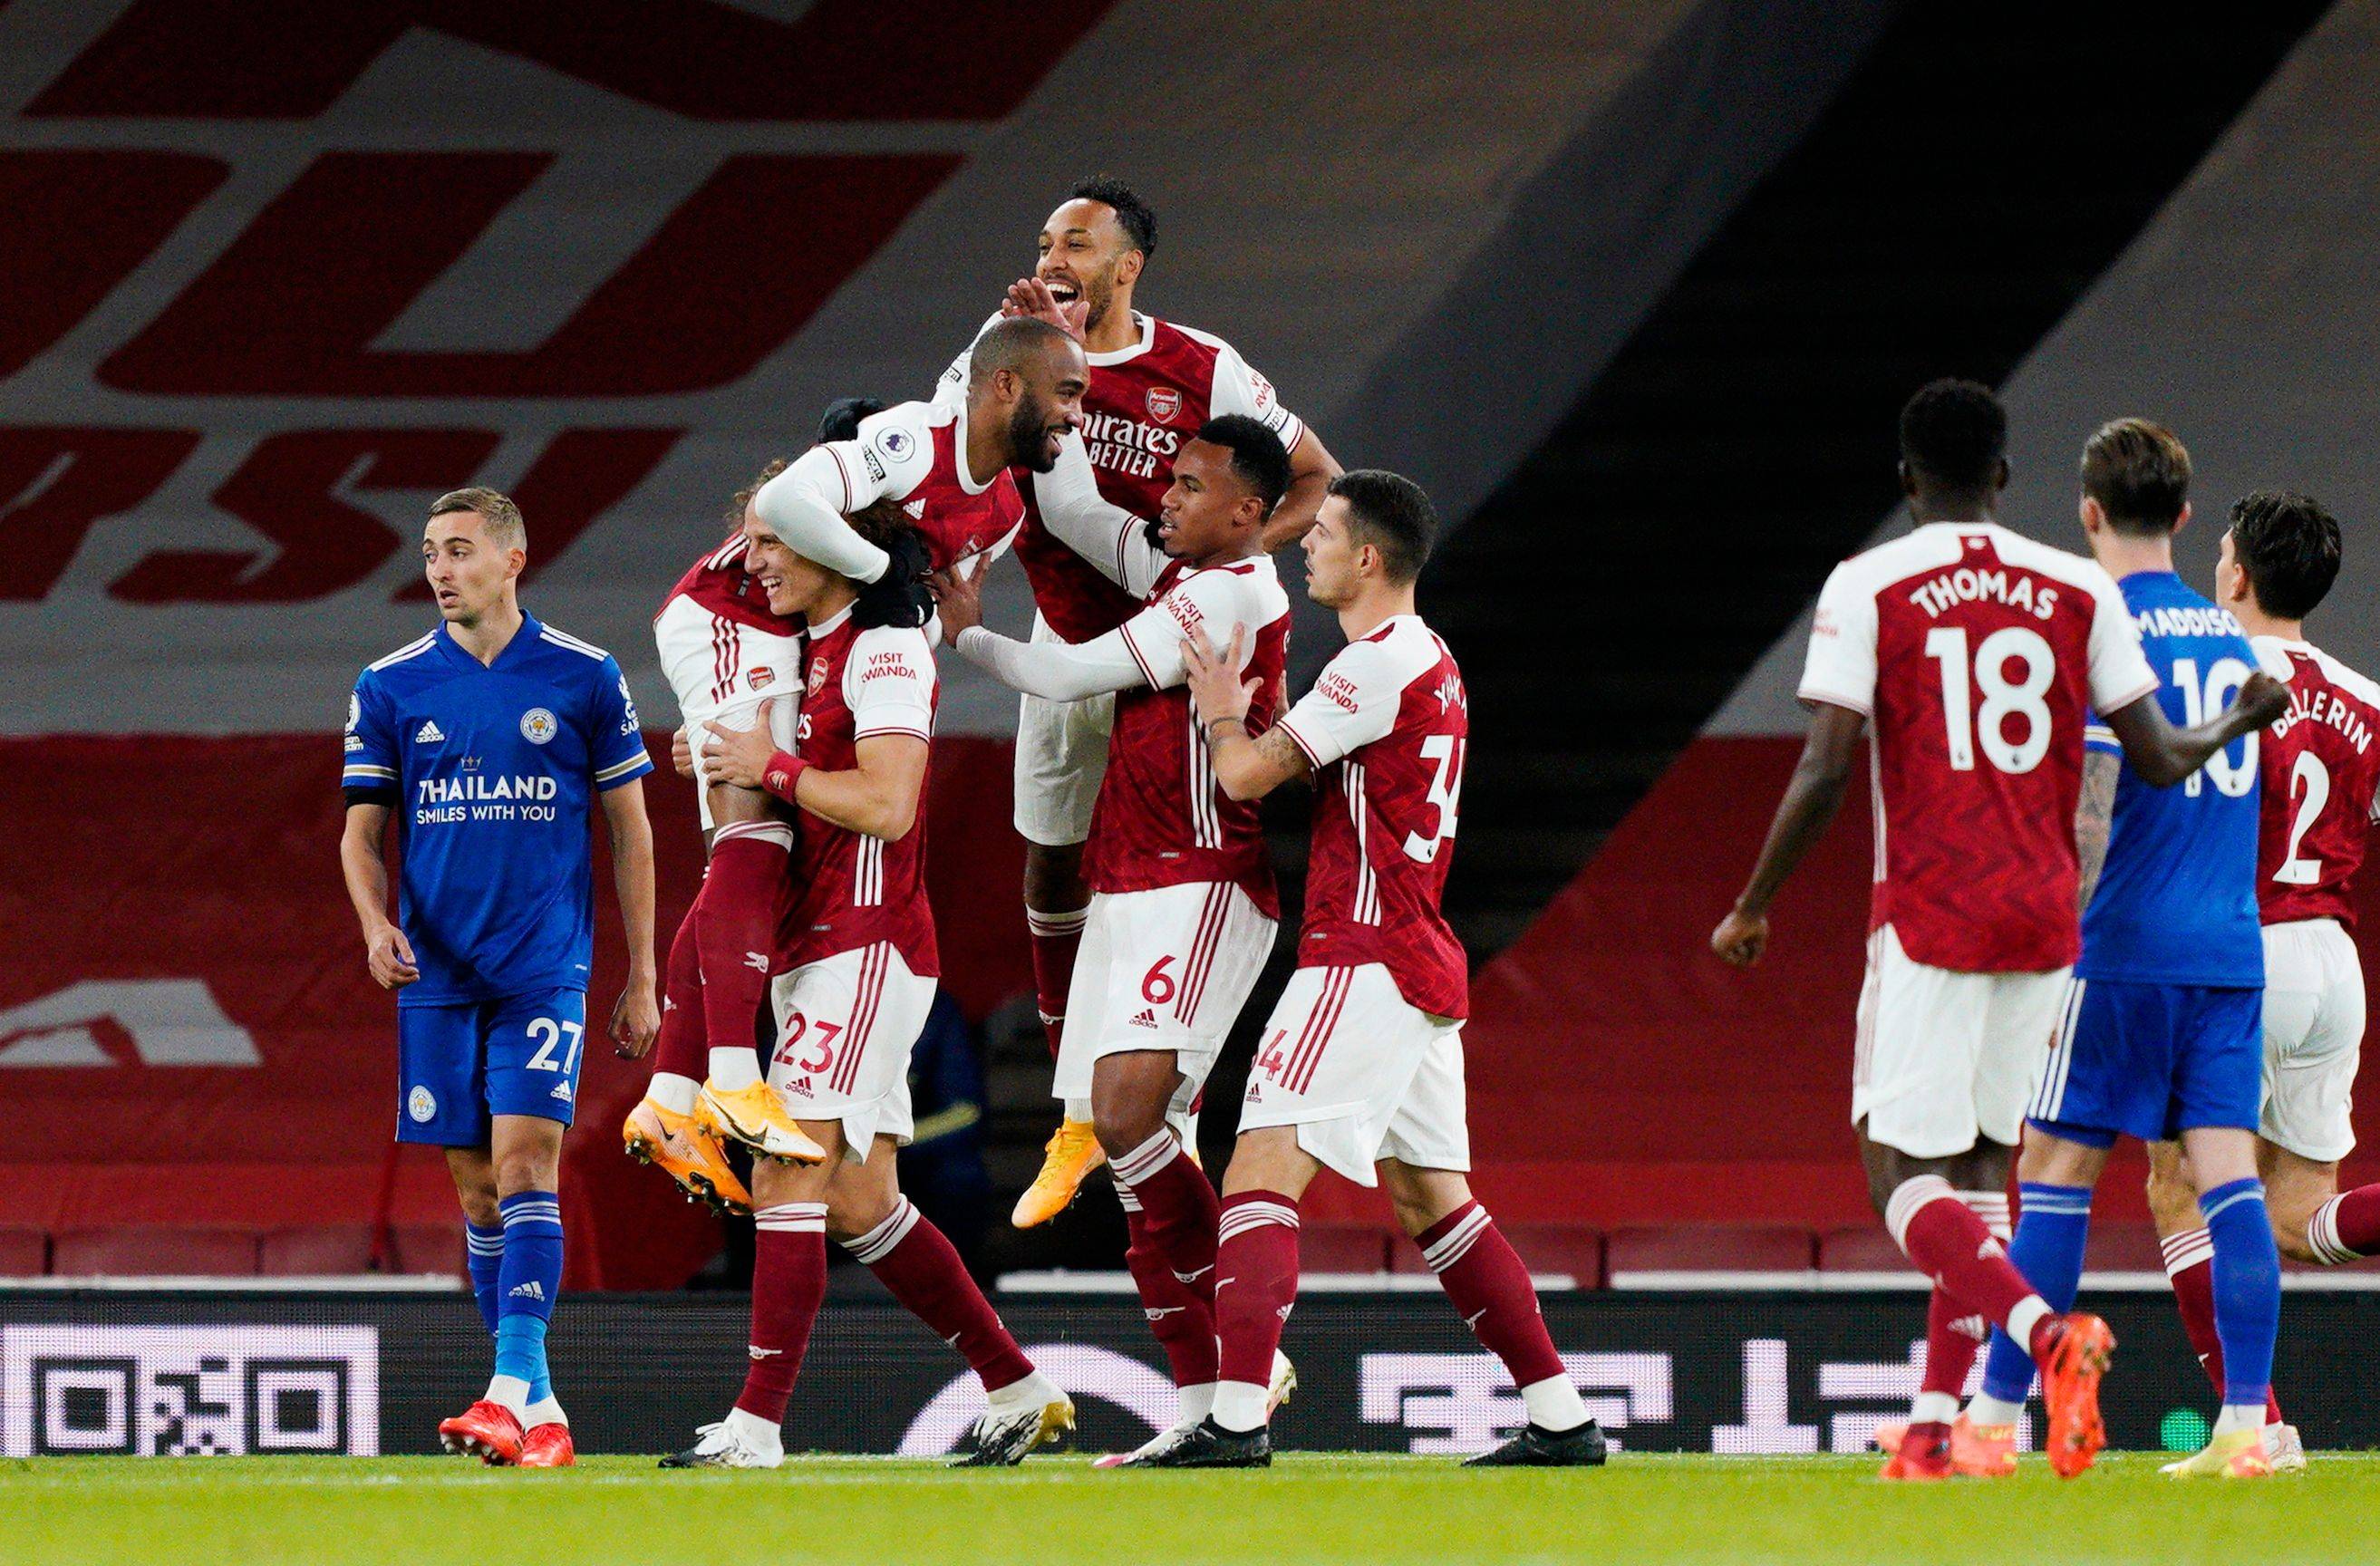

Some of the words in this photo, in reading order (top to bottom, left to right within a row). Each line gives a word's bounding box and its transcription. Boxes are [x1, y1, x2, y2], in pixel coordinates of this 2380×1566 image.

[1082, 410, 1178, 455] irates
[1089, 441, 1156, 478] BETTER
[1179, 592, 1205, 623] VISIT
[1909, 568, 2059, 620] THOMAS
[1166, 594, 1197, 644] WAND
[2137, 606, 2243, 636] MADDISO
[869, 652, 904, 665] VISIT
[1328, 672, 1359, 696] VISIT
[1924, 626, 2056, 774] 18
[2172, 658, 2259, 798] 10
[419, 775, 557, 804] THAILAND
[417, 807, 467, 825] SMILES
[470, 806, 515, 820] WITH
[519, 806, 556, 822] YOU
[2272, 749, 2330, 884] 2
[1141, 954, 1176, 1004] 6
[526, 1017, 584, 1076] 27
[773, 1011, 843, 1074] 23
[785, 1082, 815, 1099] adidas
